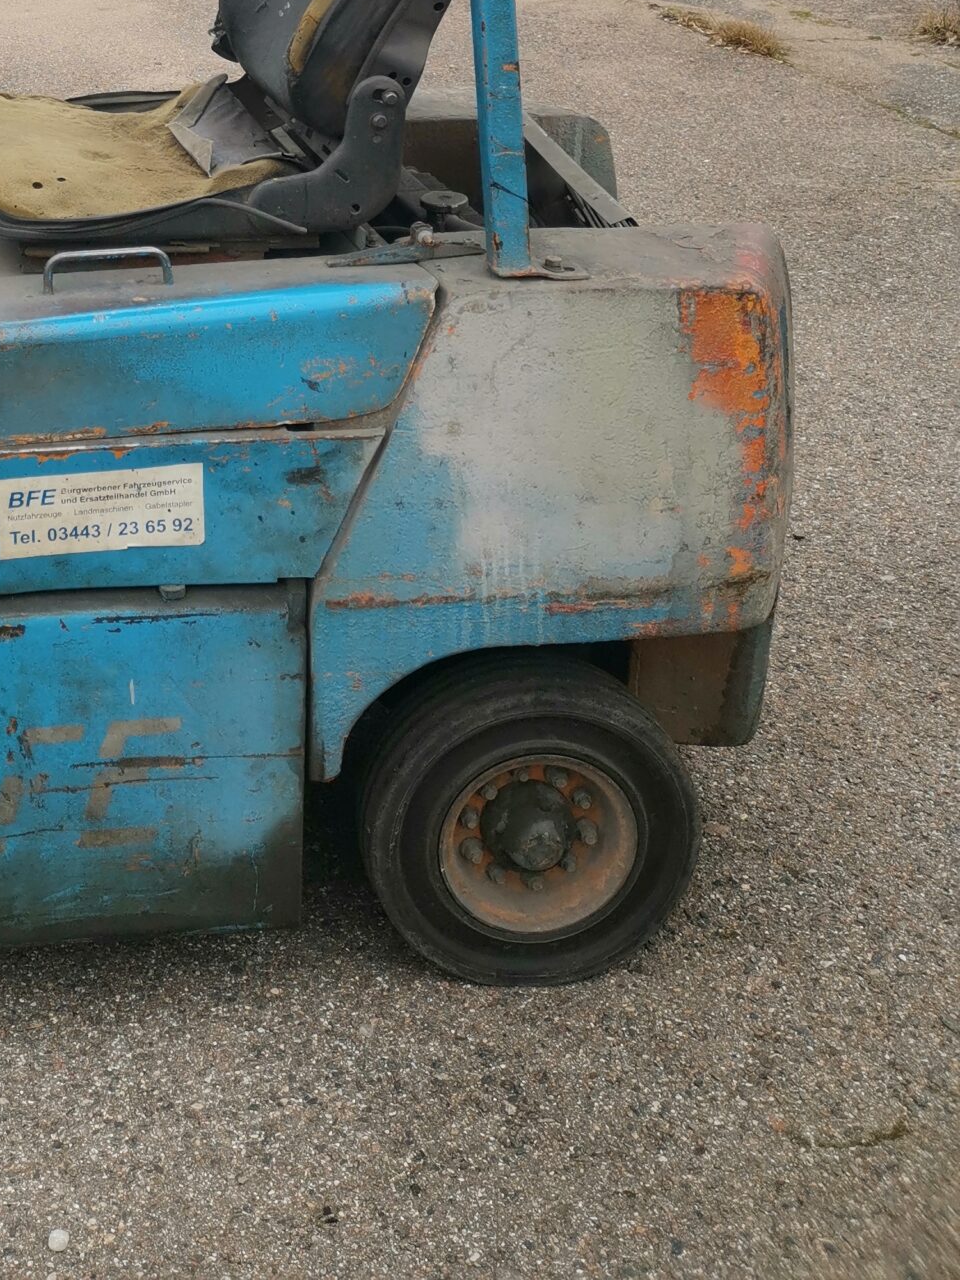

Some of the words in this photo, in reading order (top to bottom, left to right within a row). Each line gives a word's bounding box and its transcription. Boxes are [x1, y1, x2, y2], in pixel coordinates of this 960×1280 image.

[123, 478, 193, 489] Fahrzeugservice
[8, 489, 57, 509] BFE
[79, 490, 148, 503] Ersatzteilhandel
[150, 488, 177, 497] GmbH
[7, 511, 63, 522] Nutzfahrzeuge
[73, 505, 134, 516] Landmaschinen
[144, 500, 193, 511] Gabelstapler
[9, 530, 41, 545] Tel.
[47, 523, 101, 542] 03443
[107, 523, 113, 537] /
[118, 522, 139, 536] 23
[145, 519, 167, 534] 65
[172, 517, 194, 532] 92
